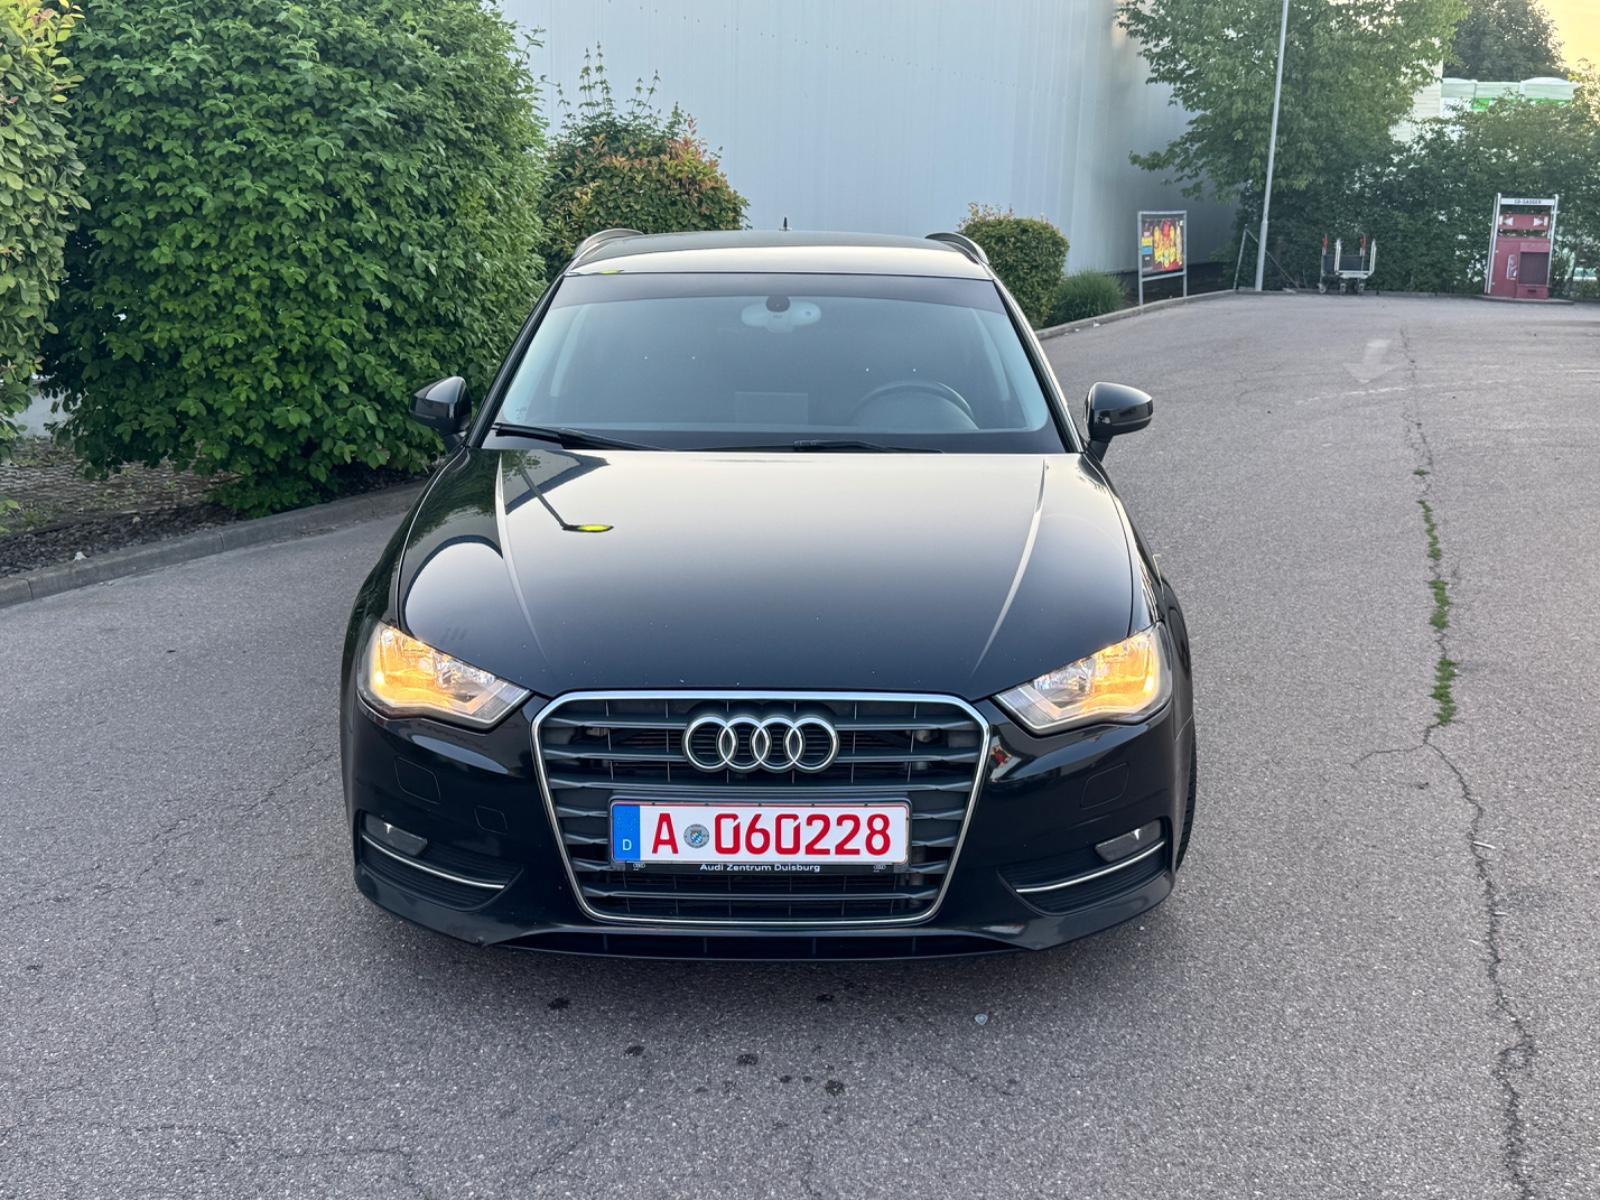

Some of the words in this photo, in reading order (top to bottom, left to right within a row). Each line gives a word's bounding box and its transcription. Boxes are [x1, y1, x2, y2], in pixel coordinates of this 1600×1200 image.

[652, 812, 679, 854] A
[714, 813, 891, 855] 060228
[622, 838, 632, 851] D
[700, 864, 724, 872] Audi
[727, 864, 772, 872] Zentrum
[774, 864, 821, 873] Duisburg
